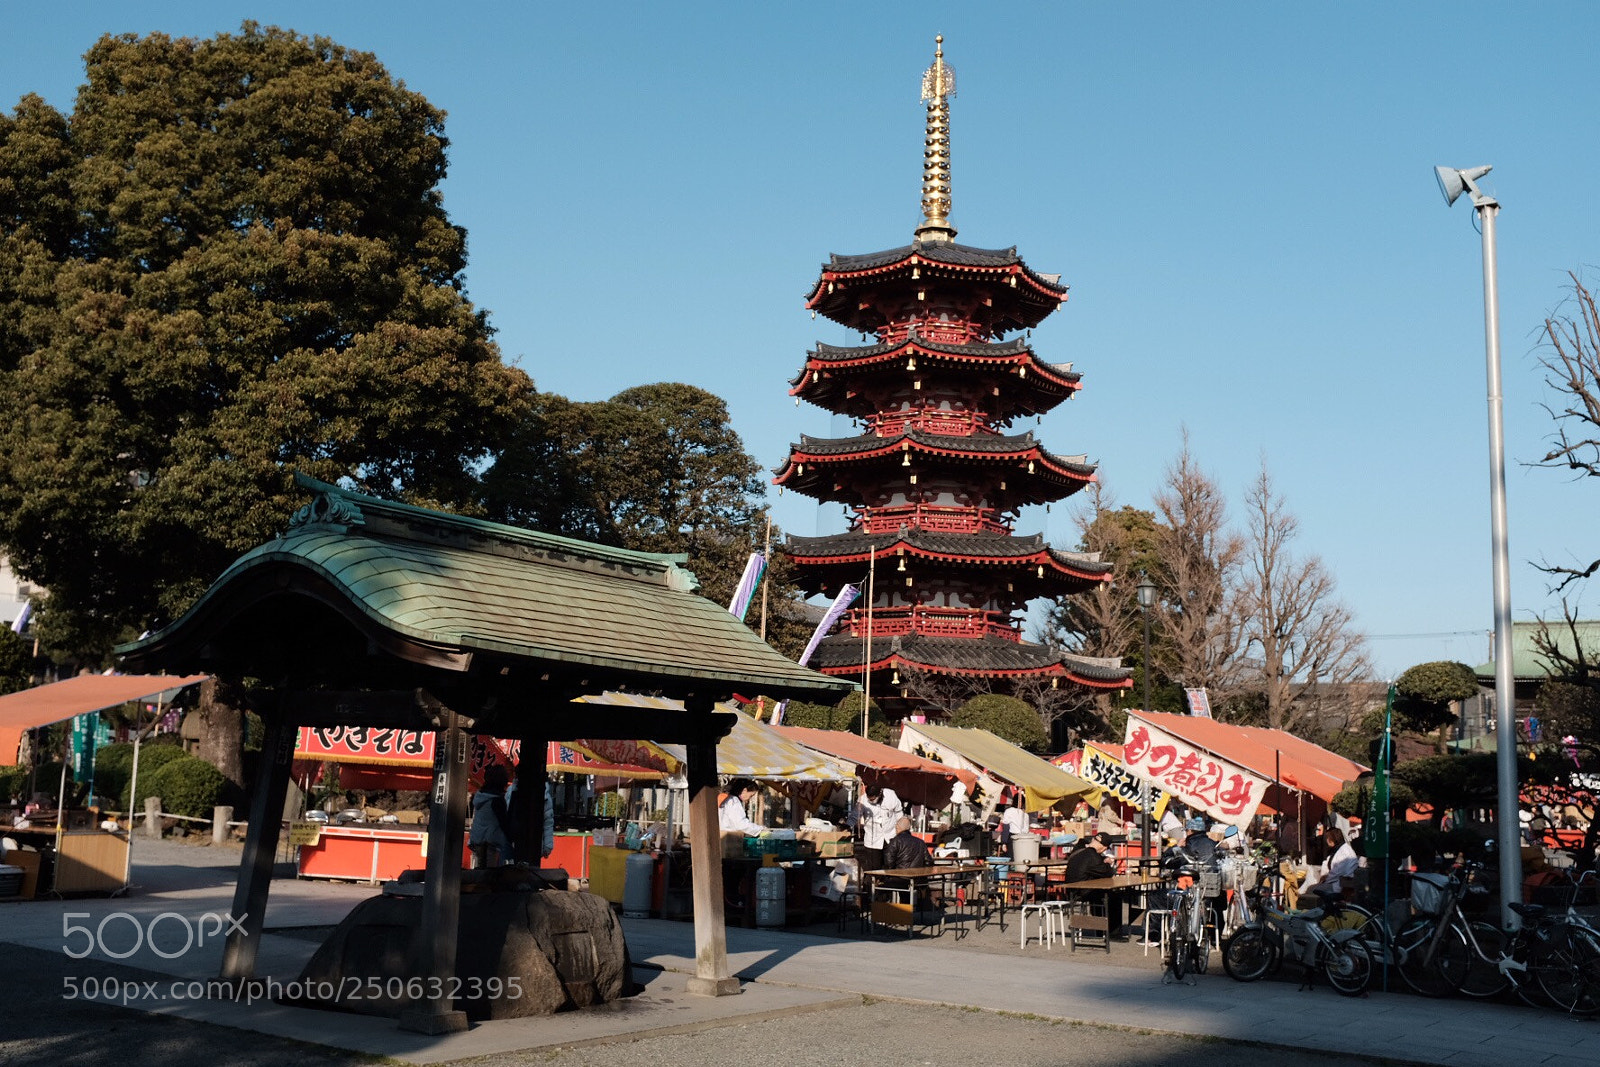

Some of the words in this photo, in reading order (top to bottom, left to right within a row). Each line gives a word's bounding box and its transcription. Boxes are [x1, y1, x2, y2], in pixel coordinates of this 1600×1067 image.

[1124, 726, 1254, 815] もつ煮込み
